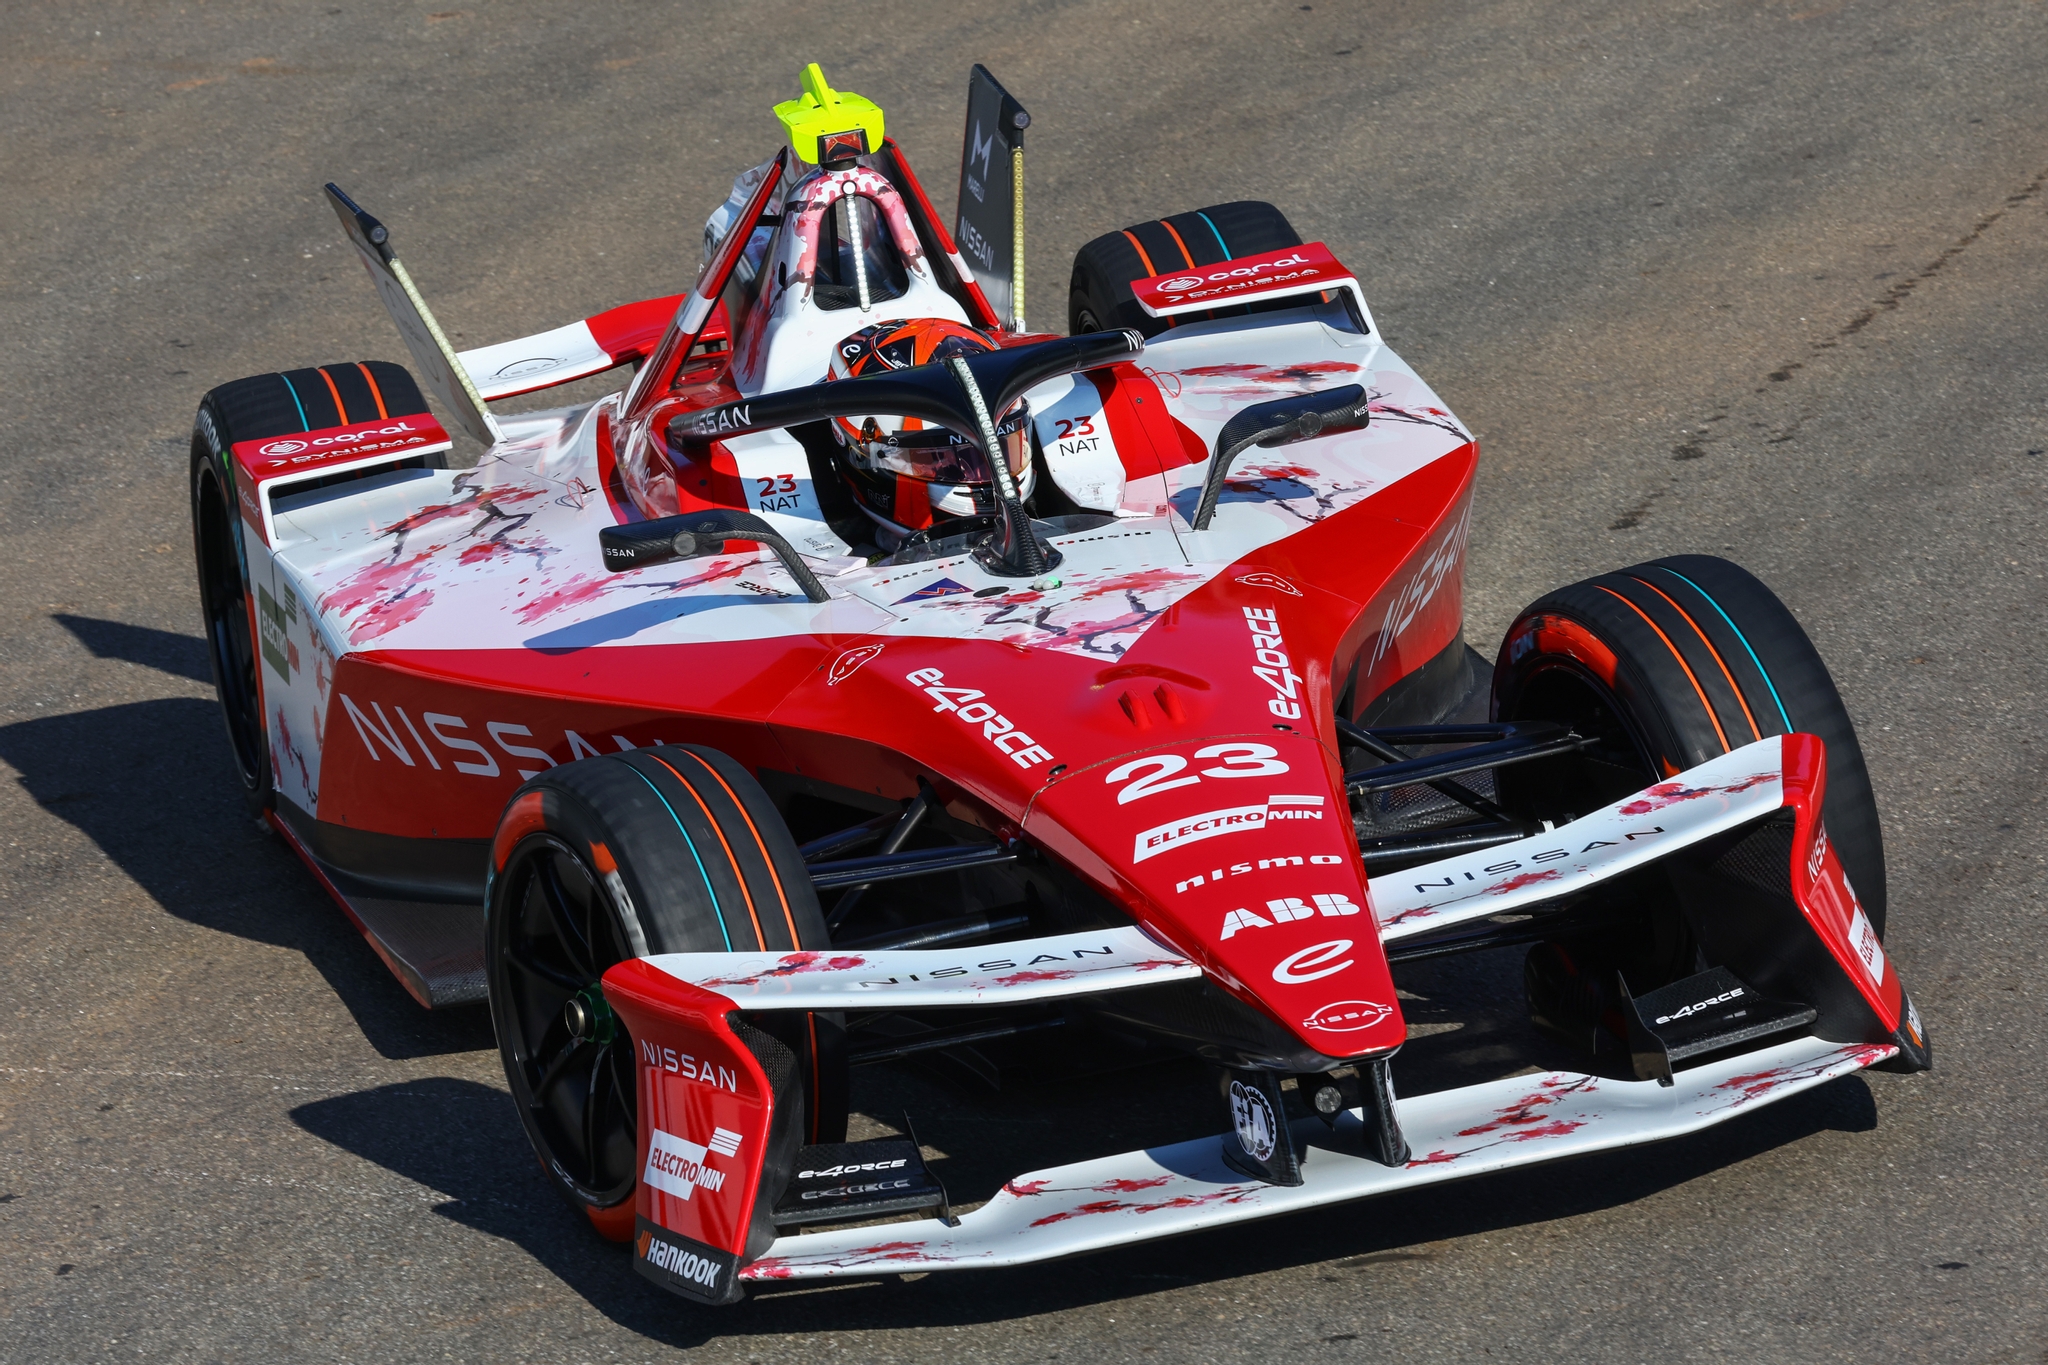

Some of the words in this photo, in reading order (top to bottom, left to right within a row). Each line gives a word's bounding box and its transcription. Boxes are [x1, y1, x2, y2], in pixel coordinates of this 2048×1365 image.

[958, 215, 995, 272] NISSAN
[1055, 415, 1095, 440] 23
[1059, 437, 1100, 457] NAT
[756, 473, 798, 498] 23
[759, 493, 801, 513] NAT
[340, 692, 665, 782] NISS
[1104, 742, 1290, 806] 23
[1146, 808, 1323, 850] ELECTROMIN
[1175, 854, 1343, 894] nismo
[1413, 826, 1665, 895] NISSAN
[1219, 892, 1360, 941] ABB
[859, 945, 1114, 989] NISSAN
[1302, 1004, 1394, 1028] NISSAN
[1655, 987, 1745, 1026] e-4ORCE
[641, 1038, 737, 1094] NISSAN
[650, 1146, 726, 1194] ELECTROMIN
[798, 1158, 908, 1179] e-4ORCE
